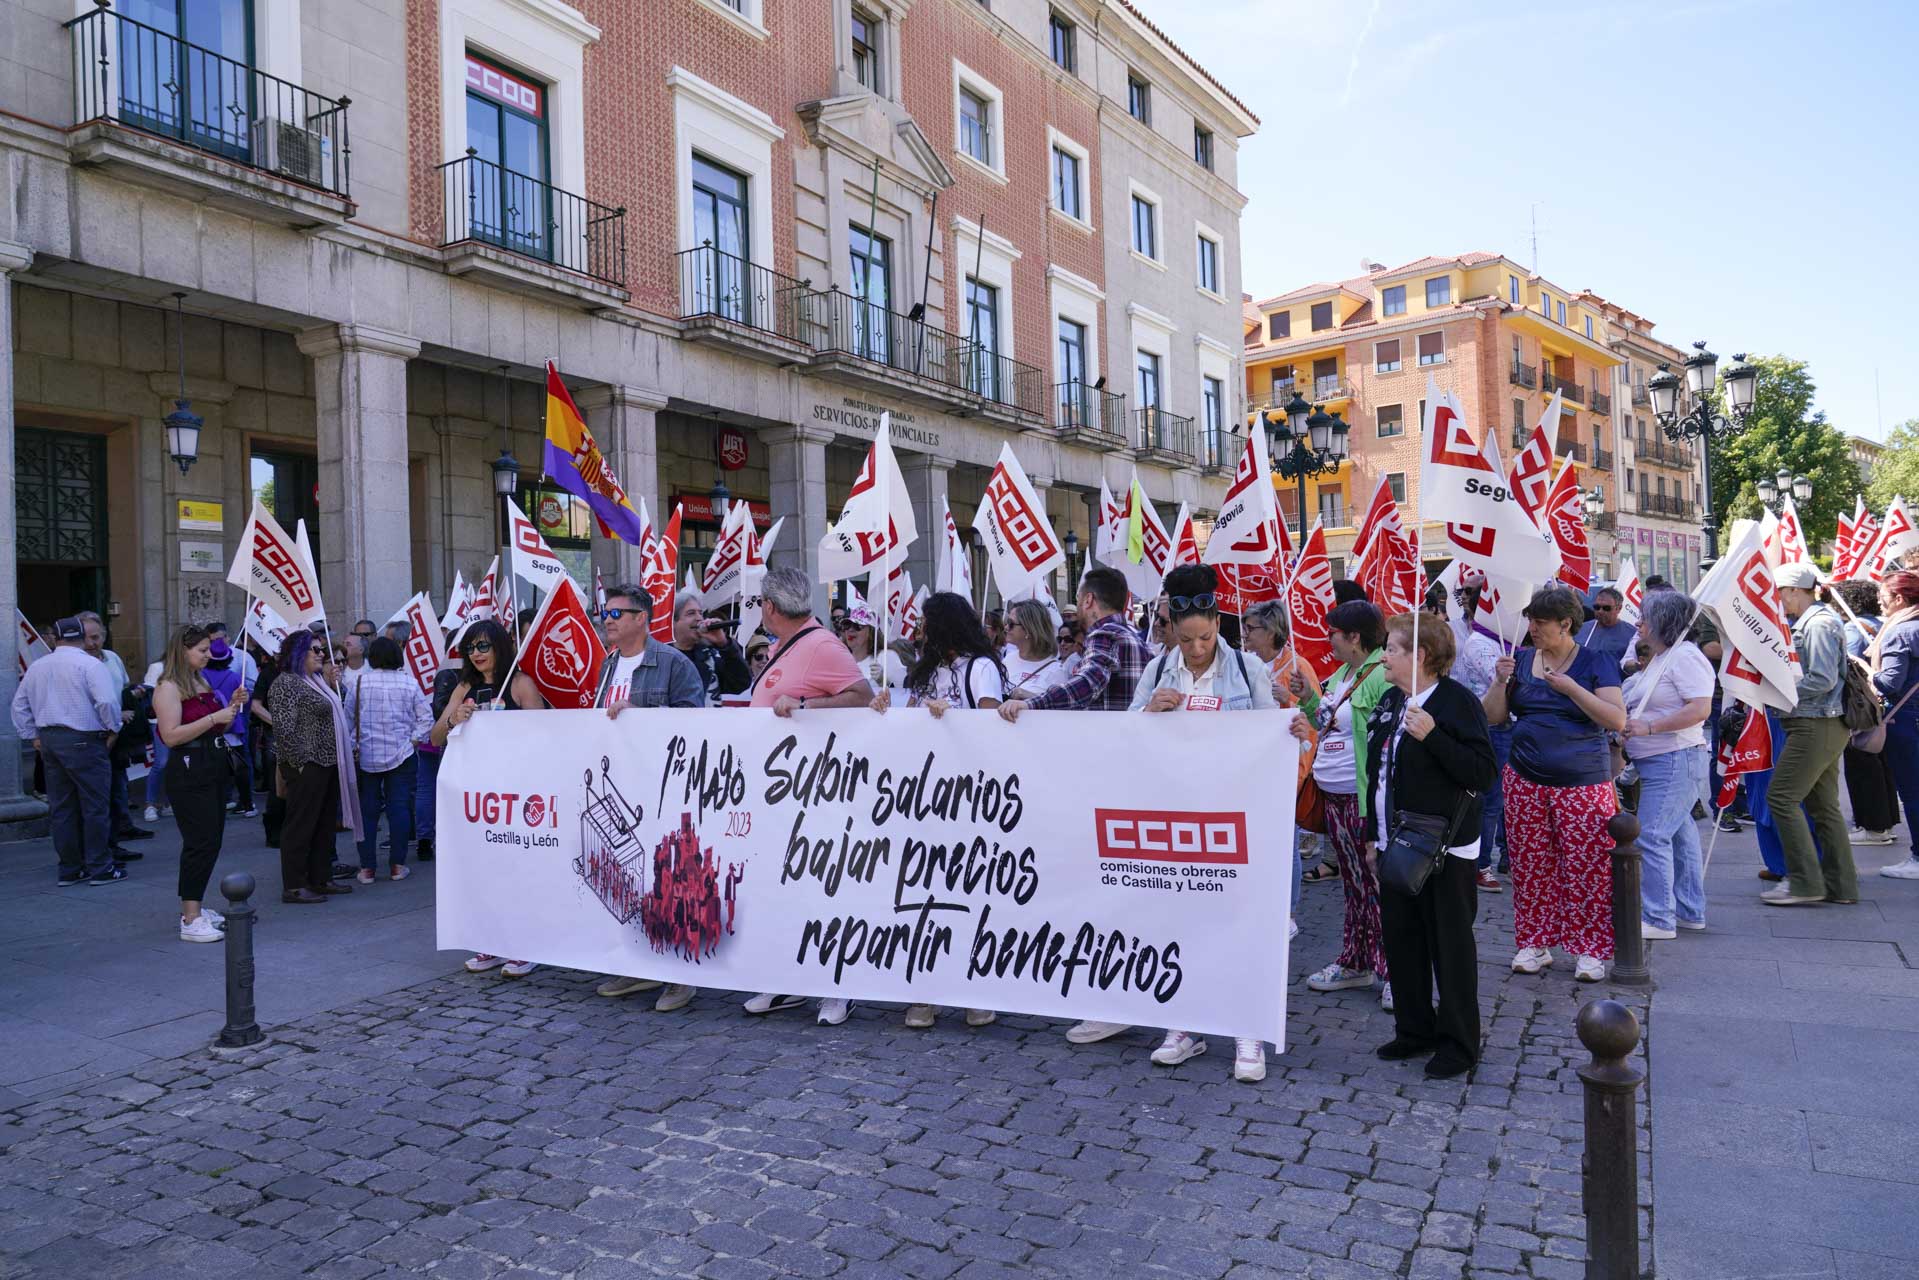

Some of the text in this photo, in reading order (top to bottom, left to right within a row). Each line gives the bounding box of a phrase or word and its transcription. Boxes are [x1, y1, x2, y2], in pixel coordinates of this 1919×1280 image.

[465, 59, 536, 112] CCOO
[843, 397, 879, 414] MINISTERIO
[723, 433, 744, 450] UGT
[687, 502, 709, 514] Unión
[989, 472, 1049, 562] CCOO
[985, 509, 1004, 556] Segovia
[712, 569, 740, 592] Castilla
[270, 583, 292, 606] León
[1732, 596, 1762, 635] Castilla
[1192, 697, 1216, 706] CCOO
[764, 732, 1023, 833] Subir salarios
[464, 791, 519, 825] UGT
[725, 811, 752, 838] 2023
[1105, 819, 1238, 853] CCOO
[485, 829, 559, 849] Castilla y León
[781, 811, 1039, 906] bajar precios
[1100, 861, 1237, 879] comisiones obreras
[1101, 874, 1224, 892] de Castilla y León
[797, 895, 1183, 1004] repartir beneficios
